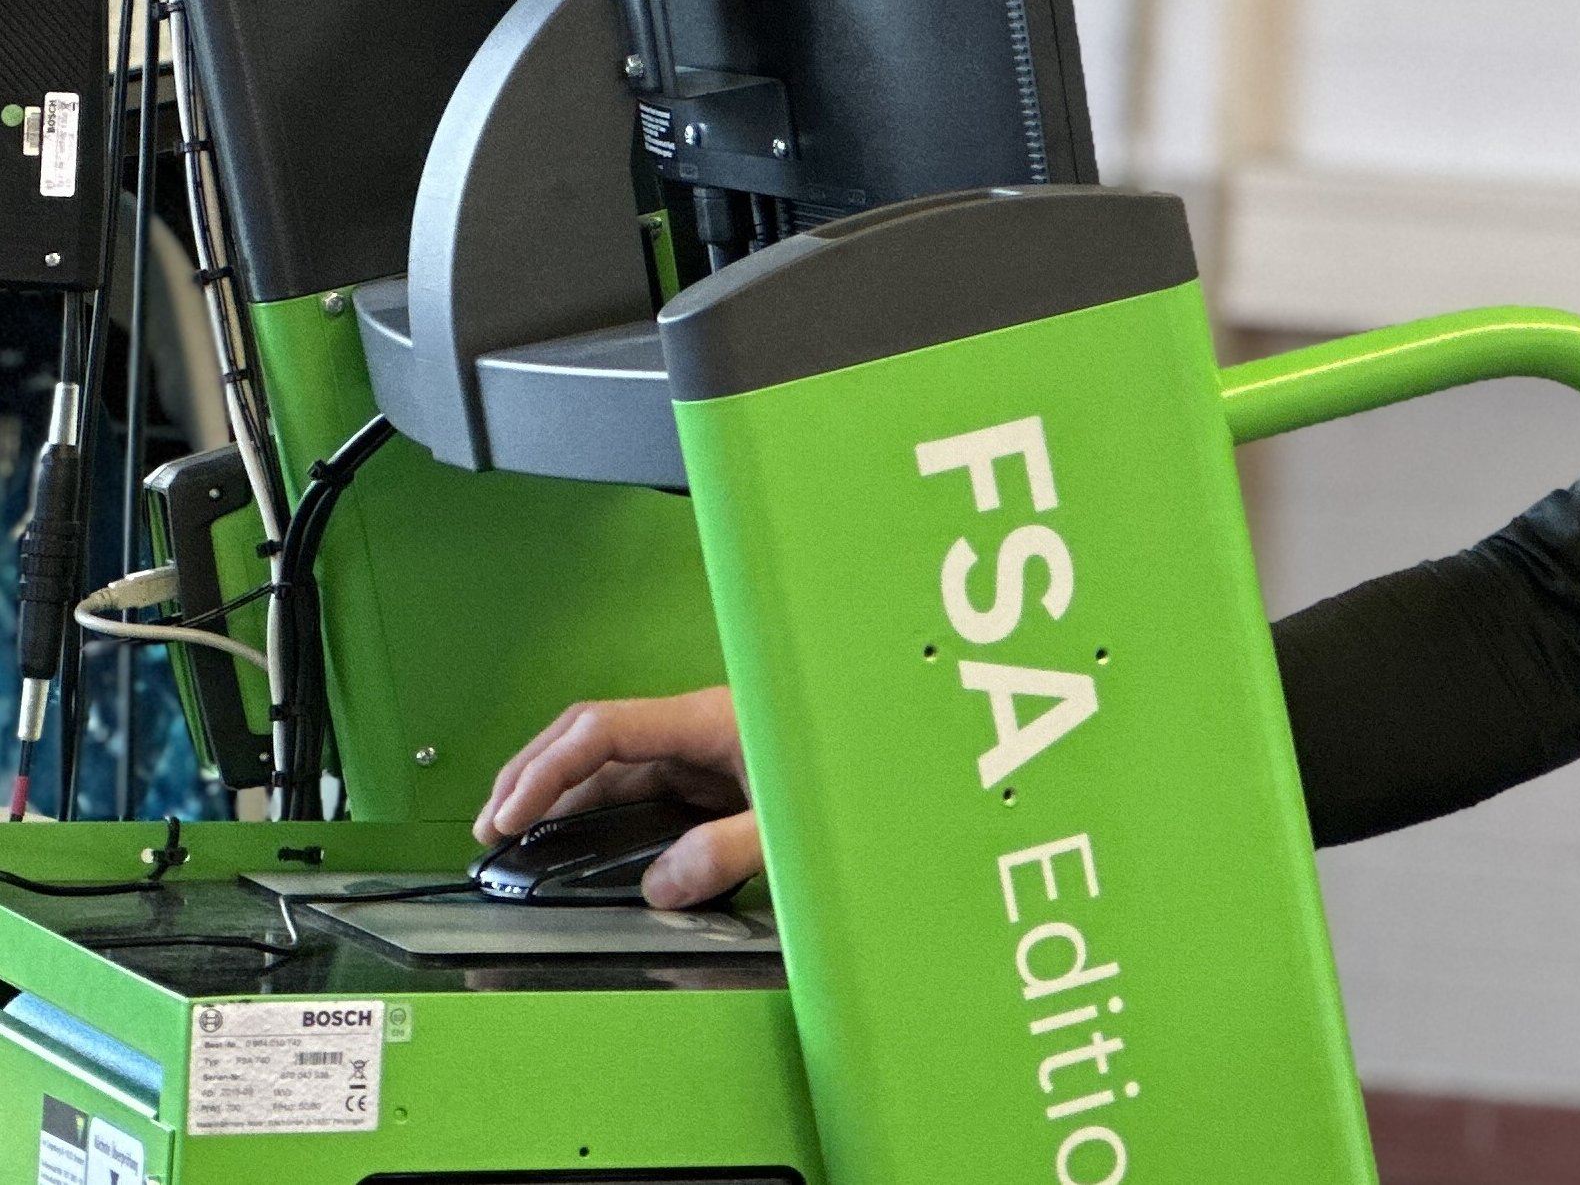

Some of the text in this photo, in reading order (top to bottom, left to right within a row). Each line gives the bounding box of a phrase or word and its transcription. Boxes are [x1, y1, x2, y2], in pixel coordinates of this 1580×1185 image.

[915, 415, 1141, 1185] FSA Editio
[302, 1010, 372, 1027] BOSCH
